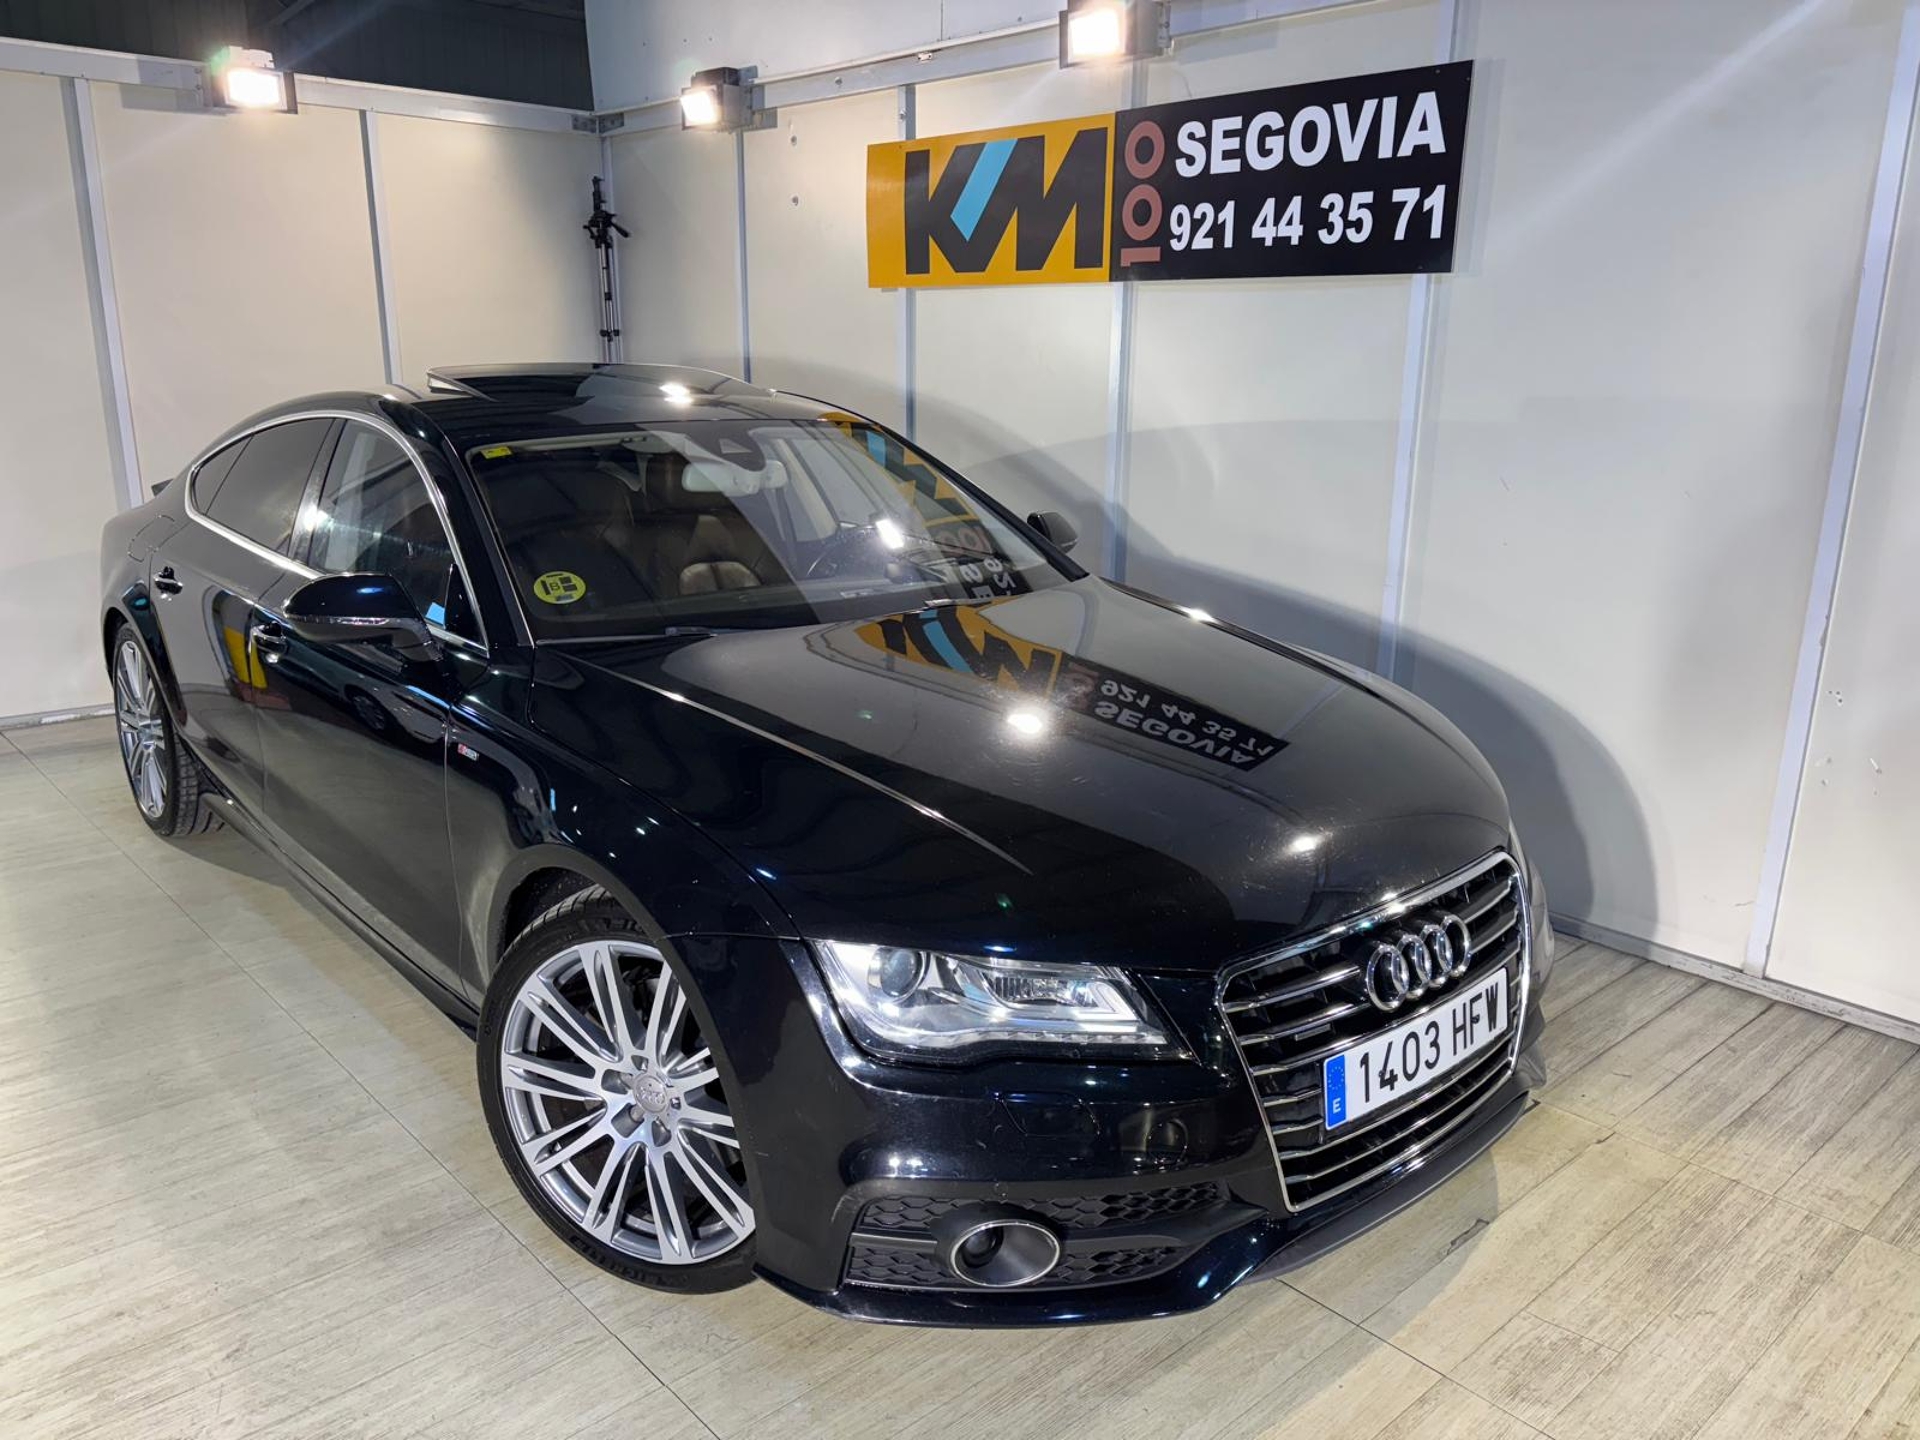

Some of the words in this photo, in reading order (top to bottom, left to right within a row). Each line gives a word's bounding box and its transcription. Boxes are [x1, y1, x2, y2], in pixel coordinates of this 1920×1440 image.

[1175, 91, 1447, 178] SEGOVIA
[904, 127, 1108, 275] KM
[1120, 120, 1165, 267] 100
[1169, 199, 1235, 251] 921
[1251, 194, 1303, 246] 44
[1318, 191, 1374, 243] 35
[1391, 184, 1447, 240] 71
[1359, 1020, 1441, 1104] 1403
[1452, 982, 1499, 1057] HFW
[1332, 1097, 1342, 1114] E
